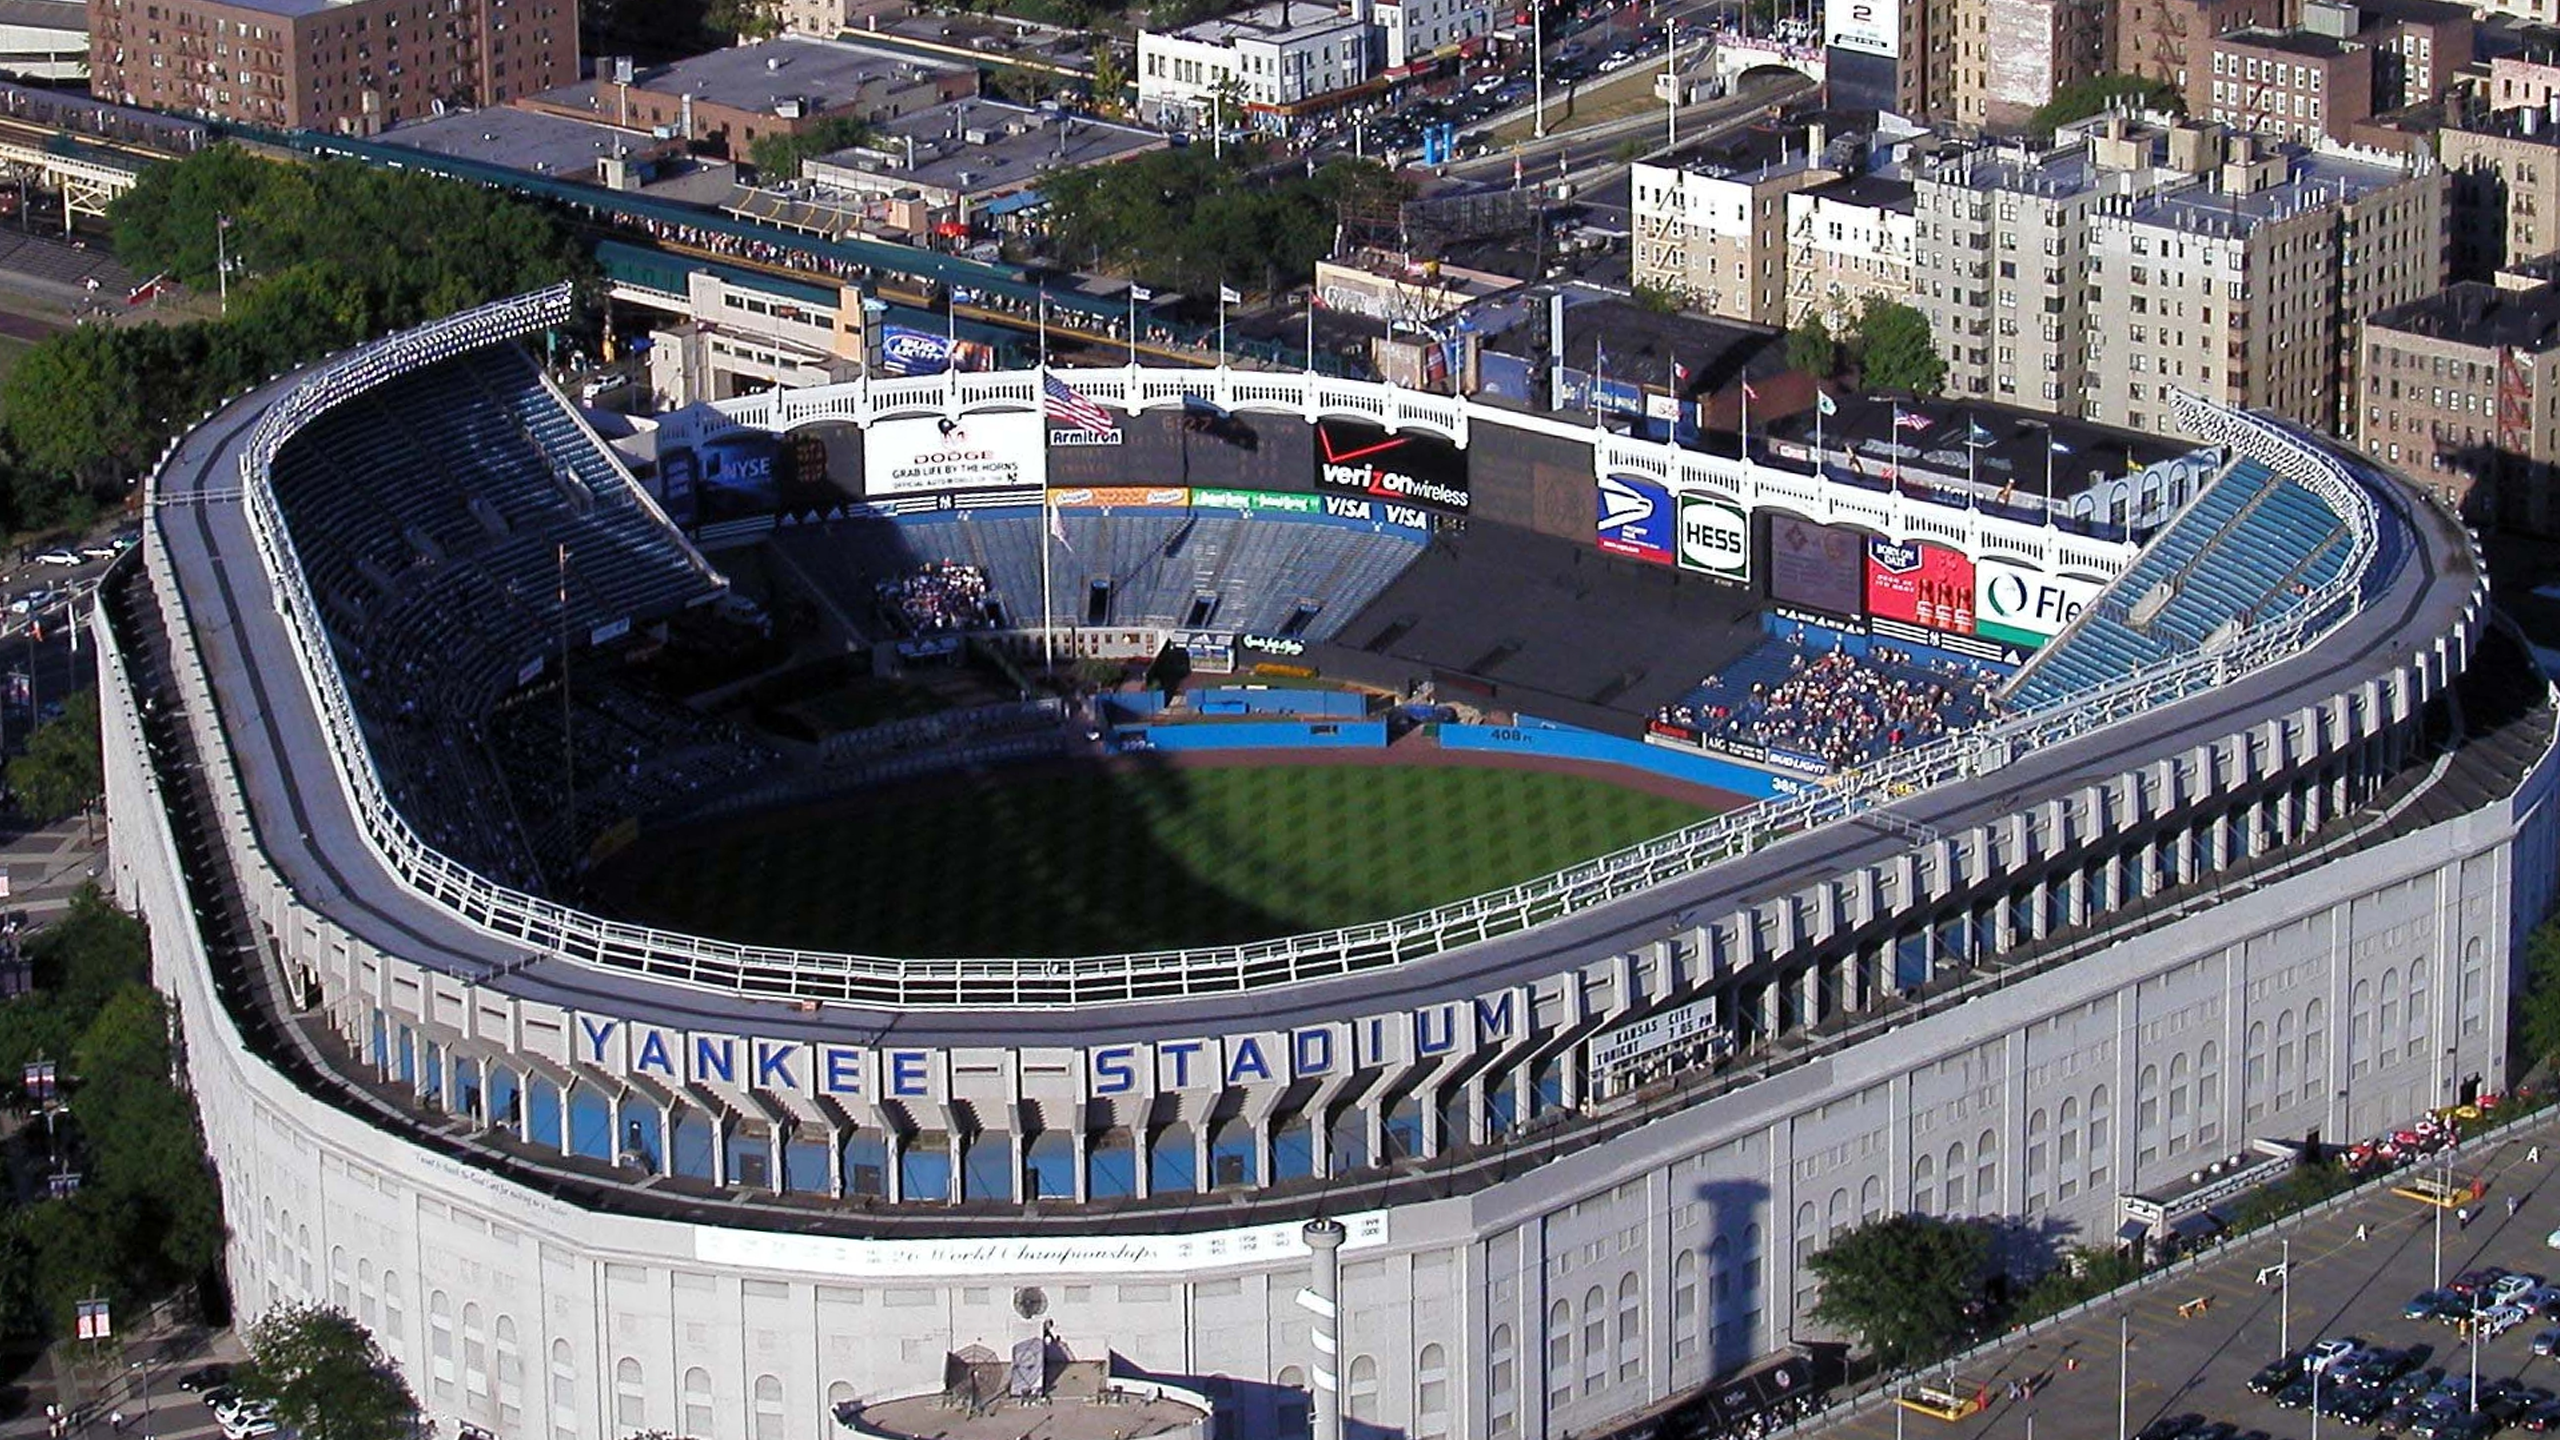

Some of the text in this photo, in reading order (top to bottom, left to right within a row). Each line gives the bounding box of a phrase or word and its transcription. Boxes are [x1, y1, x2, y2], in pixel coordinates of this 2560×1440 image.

[1853, 5, 1872, 22] 2
[900, 338, 937, 353] BUD
[1053, 430, 1119, 443] Armitron
[727, 457, 771, 478] NYSE
[913, 451, 994, 465] DODGE
[892, 462, 1018, 479] GRAB LIFE BY THE HORNS
[1322, 463, 1469, 507] verizon wireless
[1325, 496, 1371, 519] VISA
[1385, 504, 1428, 530] VISA
[1687, 521, 1742, 554] HESS
[1491, 729, 1521, 741] 408
[1708, 737, 1726, 750] AIG
[1769, 752, 1827, 776] BUD LIGHT
[1615, 1007, 1692, 1044] KANSAS CITY
[1096, 990, 1514, 1094] STADIUM
[1596, 1040, 1640, 1065] TONIGHT
[1699, 1013, 1713, 1027] PM
[579, 1015, 928, 1096] YANKEE
[932, 1245, 997, 1261] World
[1001, 1243, 1159, 1265] Championships
